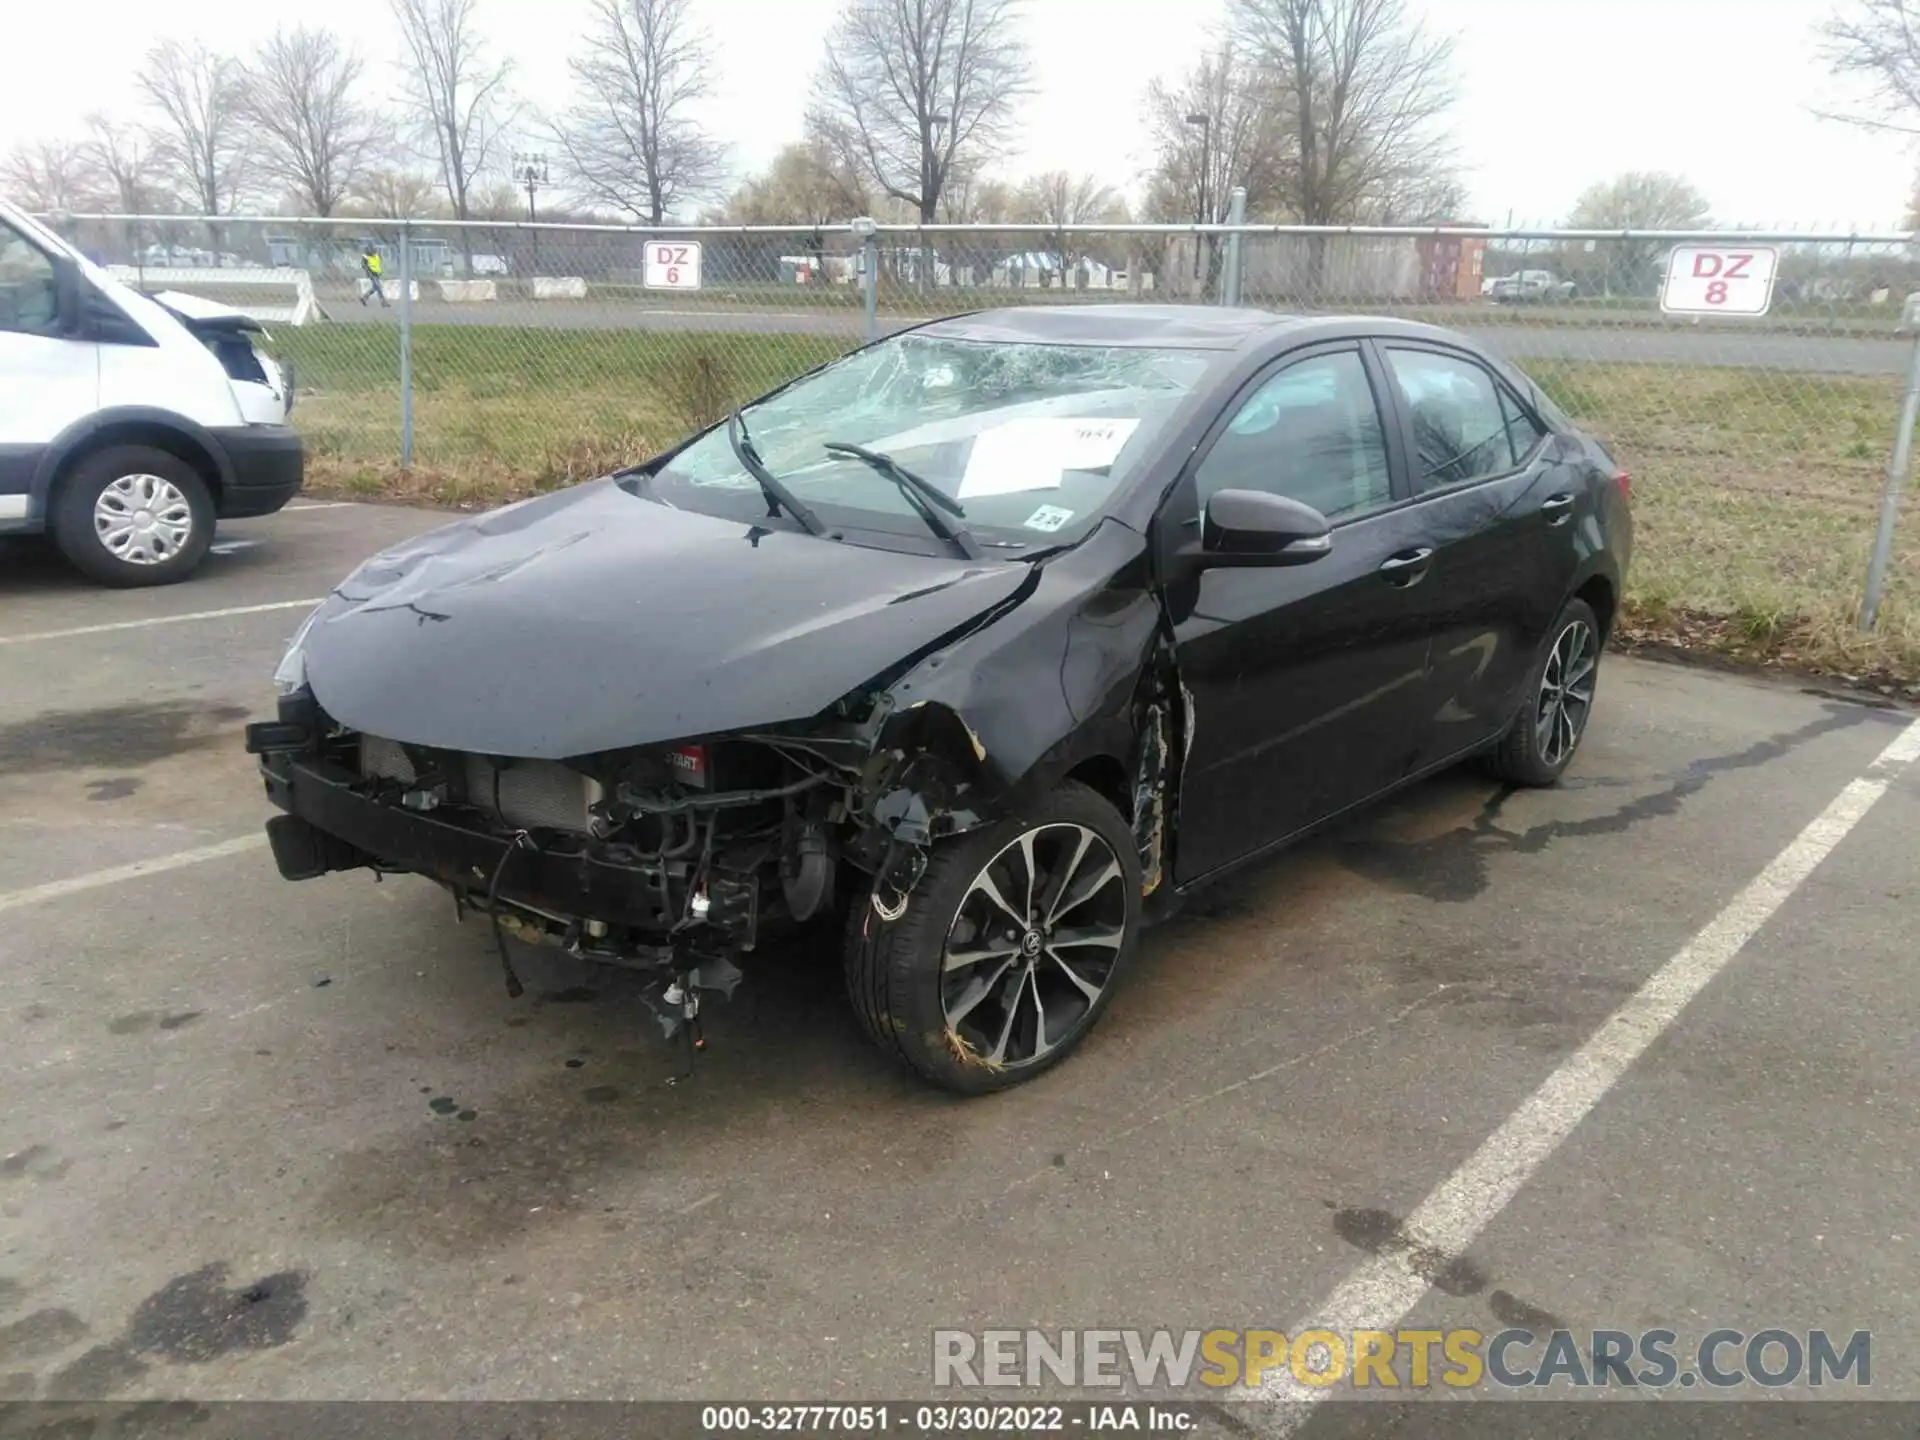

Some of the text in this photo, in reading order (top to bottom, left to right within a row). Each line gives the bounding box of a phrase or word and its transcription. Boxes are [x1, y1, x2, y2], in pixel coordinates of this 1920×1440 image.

[657, 247, 689, 264] DZ
[1692, 253, 1754, 277] DZ
[667, 267, 679, 283] 6
[1705, 281, 1728, 304] 8
